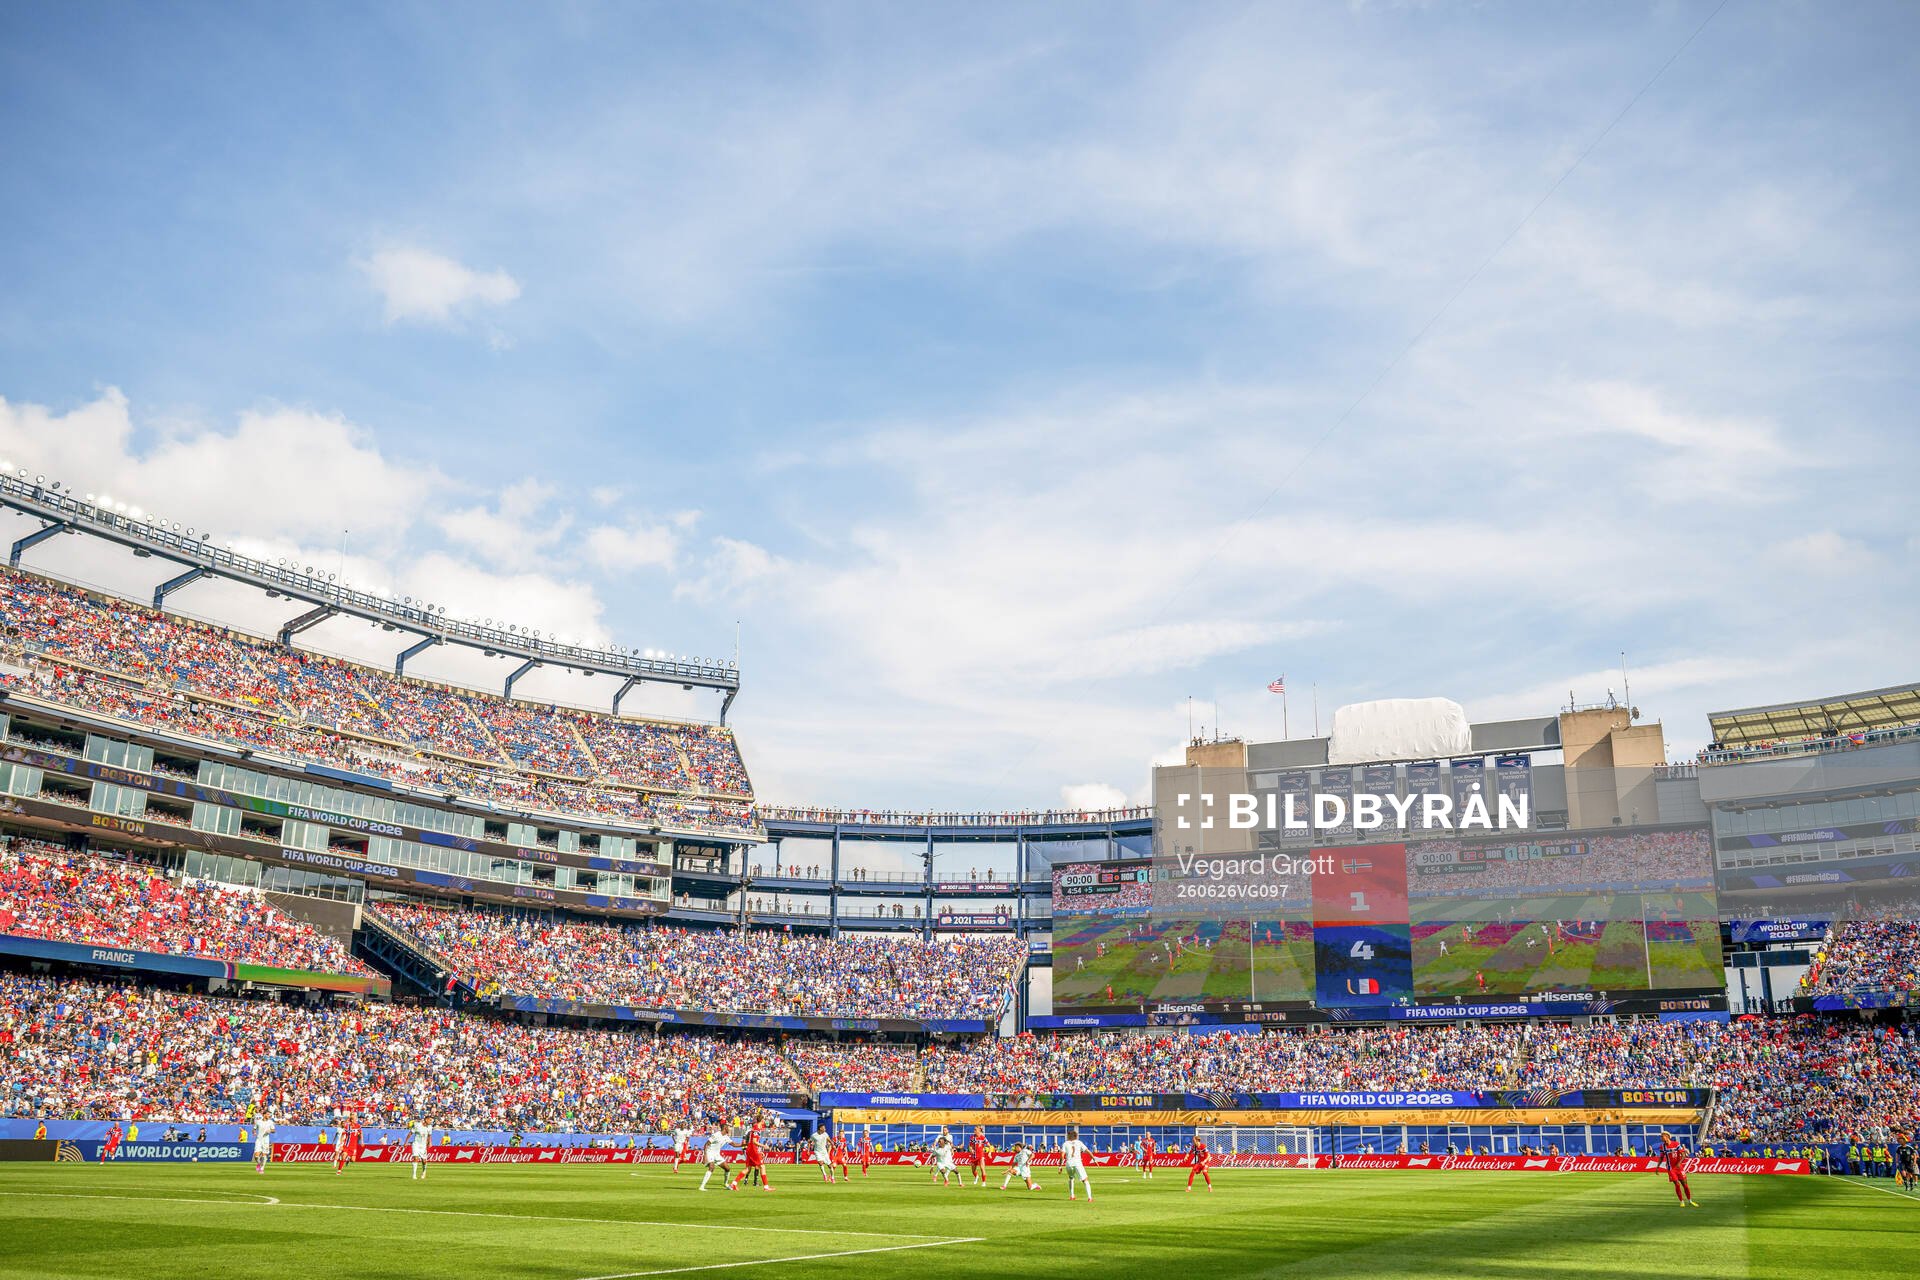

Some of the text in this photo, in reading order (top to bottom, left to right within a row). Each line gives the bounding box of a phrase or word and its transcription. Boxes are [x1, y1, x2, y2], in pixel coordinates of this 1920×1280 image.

[100, 768, 152, 786] BOSTON
[92, 814, 144, 833] BOSTON
[288, 806, 403, 836] FIFA WORLD CUP 2026
[1284, 829, 1309, 838] 2001
[1781, 831, 1834, 843] #FIFAWorldCup
[1532, 847, 1539, 856] 4
[282, 849, 398, 877] FIFA WORLD CUP 2026
[1422, 853, 1452, 863] 90:00
[1067, 876, 1092, 885] 90:00
[1121, 873, 1135, 881] NOR
[1160, 870, 1166, 879] 4
[1786, 872, 1839, 884] #FIFAWorldCup
[1351, 892, 1370, 911] 1
[953, 916, 971, 924] 2021
[1351, 940, 1374, 960] 4
[92, 950, 135, 964] FRANCE
[1538, 992, 1593, 1001] Hisense
[1158, 1004, 1205, 1012] Hisense
[1429, 1007, 1466, 1016] WORLD
[1468, 1007, 1488, 1015] CUP
[1490, 1006, 1528, 1014] 2026
[1660, 1000, 1710, 1010] BOSTON
[871, 1096, 918, 1105] #FIFAWorldCup
[1102, 1096, 1152, 1106] BOSTON
[1300, 1094, 1453, 1105] FIFA WORLD CUP 2026
[1622, 1092, 1686, 1102] BOSTON
[126, 1145, 173, 1158] WORLD
[177, 1146, 197, 1158] CUP
[198, 1147, 237, 1158] 2026
[479, 1148, 533, 1163] Budweiser
[560, 1148, 608, 1163] Budweiser
[631, 1149, 674, 1164] Budweiser
[1218, 1154, 1290, 1168] Budweiser
[1325, 1155, 1400, 1168] Budweiser
[1438, 1156, 1515, 1170] Budweiser
[1555, 1156, 1636, 1172] Budweiser
[1682, 1158, 1764, 1173] Budweiser
